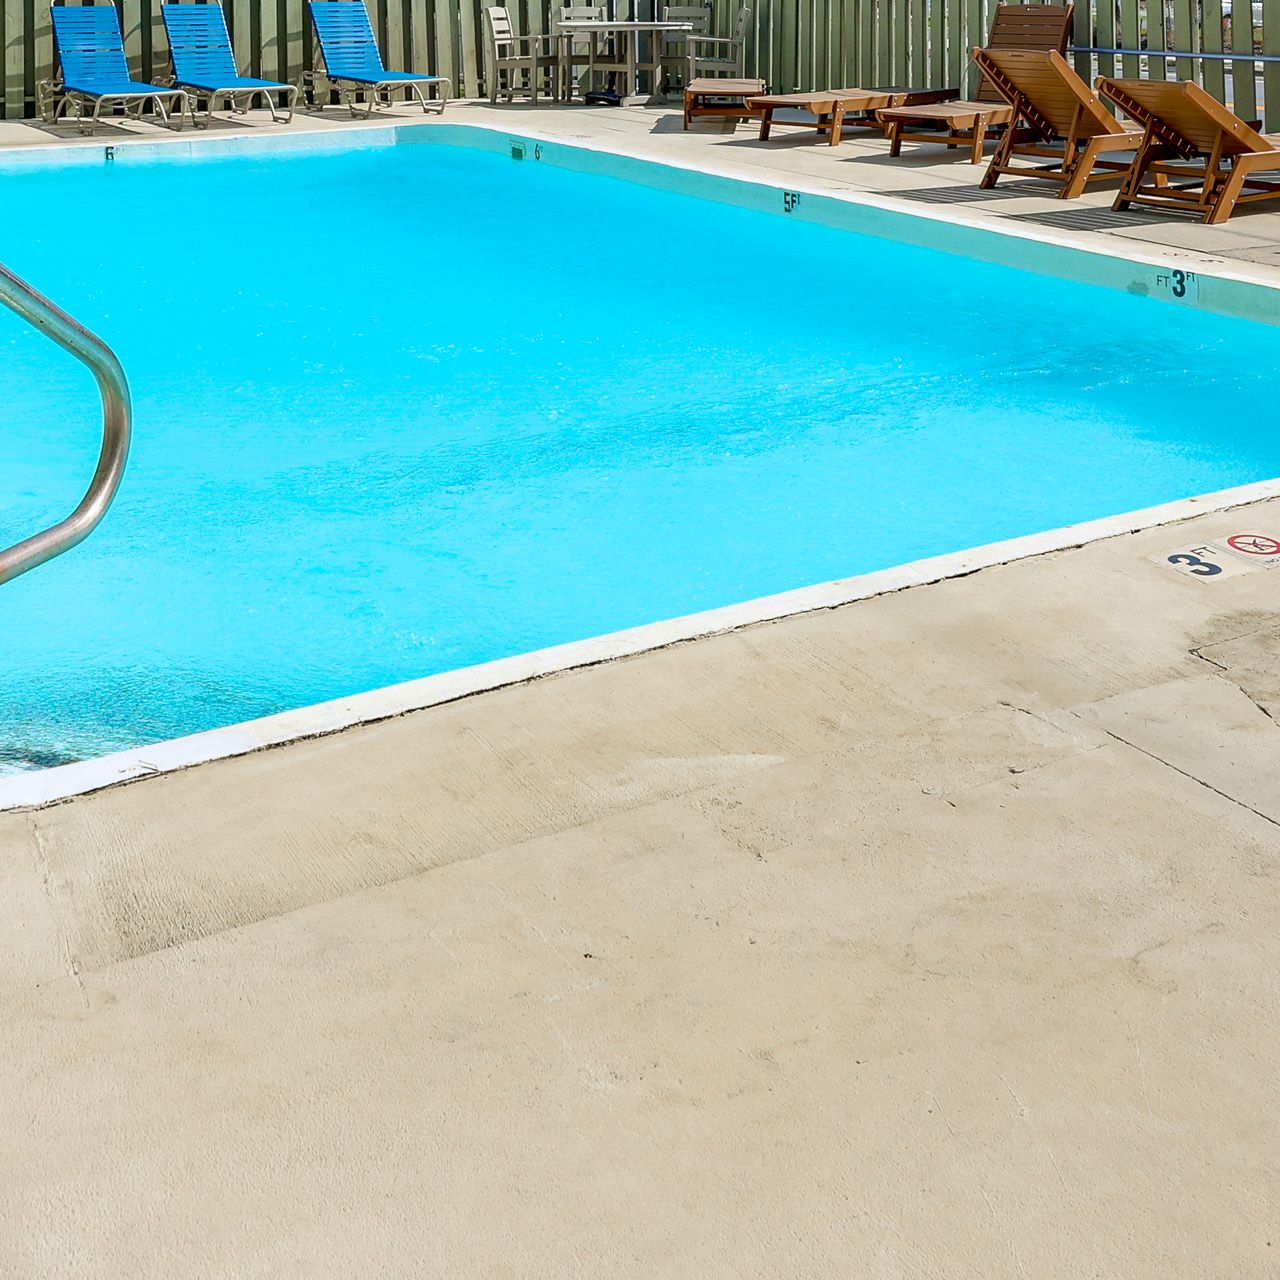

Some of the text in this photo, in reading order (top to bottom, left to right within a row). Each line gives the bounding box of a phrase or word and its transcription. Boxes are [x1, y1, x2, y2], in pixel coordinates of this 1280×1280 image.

[1157, 270, 1195, 297] FT 3 FT
[1190, 546, 1216, 557] FT
[1168, 554, 1222, 575] 3
